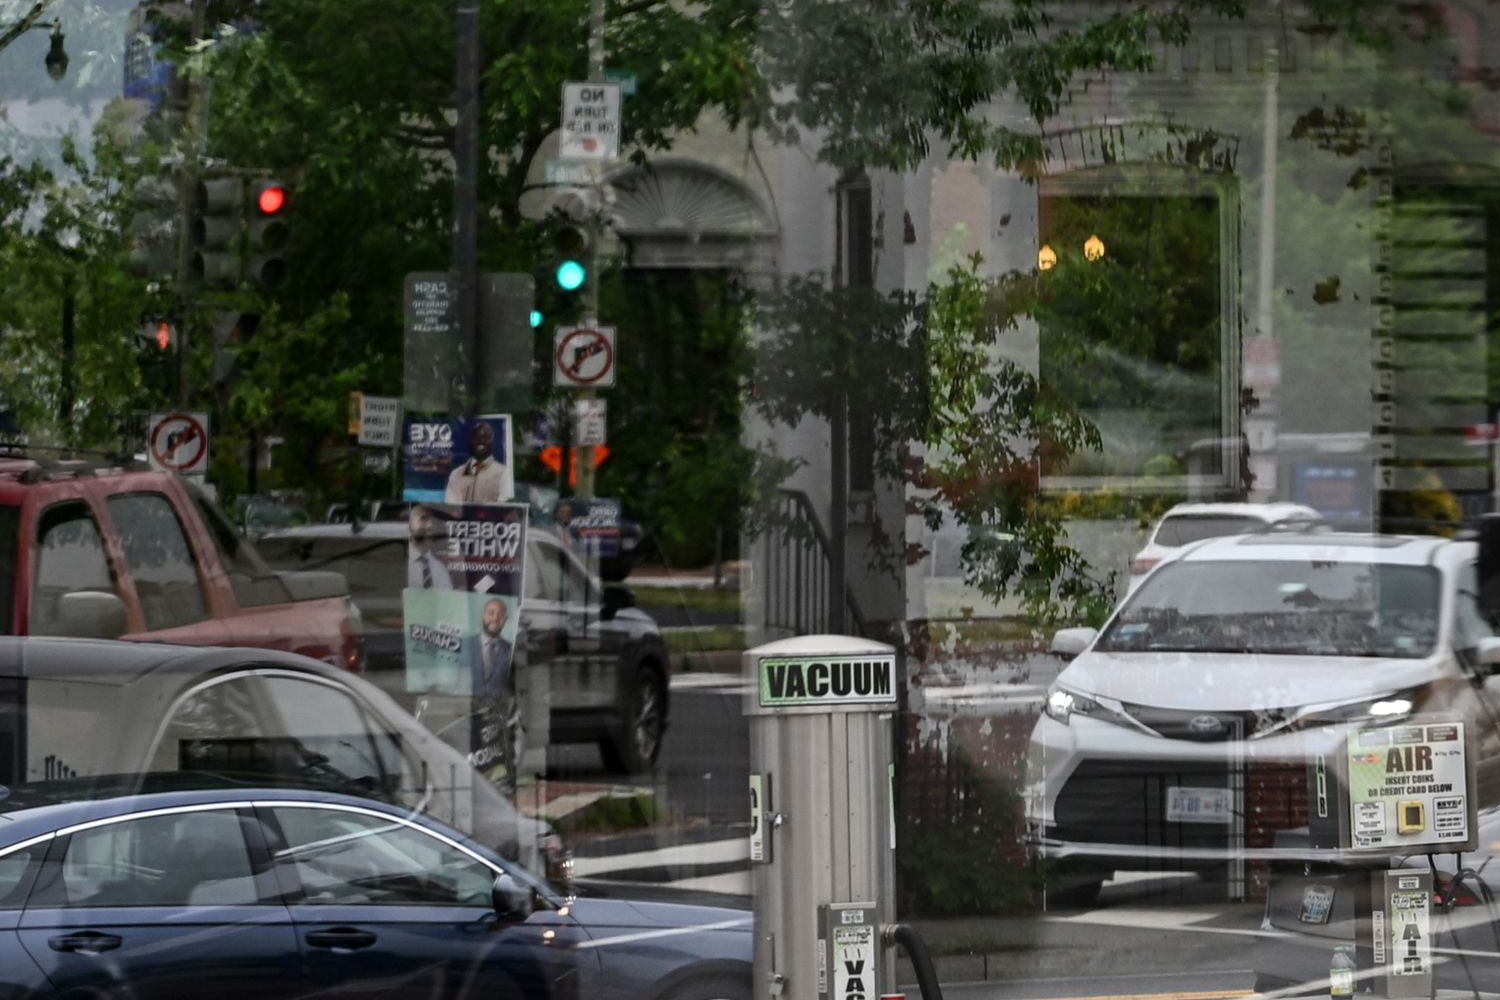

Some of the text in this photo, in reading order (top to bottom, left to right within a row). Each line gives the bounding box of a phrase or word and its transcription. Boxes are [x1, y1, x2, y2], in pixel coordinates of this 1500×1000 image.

[767, 662, 891, 698] VACUUM
[1386, 745, 1433, 774] AIR
[1317, 756, 1326, 815] AIR
[1367, 783, 1453, 797] OR CREDIT CARD BELOW
[1385, 774, 1435, 785] INSERT COINS
[1402, 923, 1423, 972] AIR
